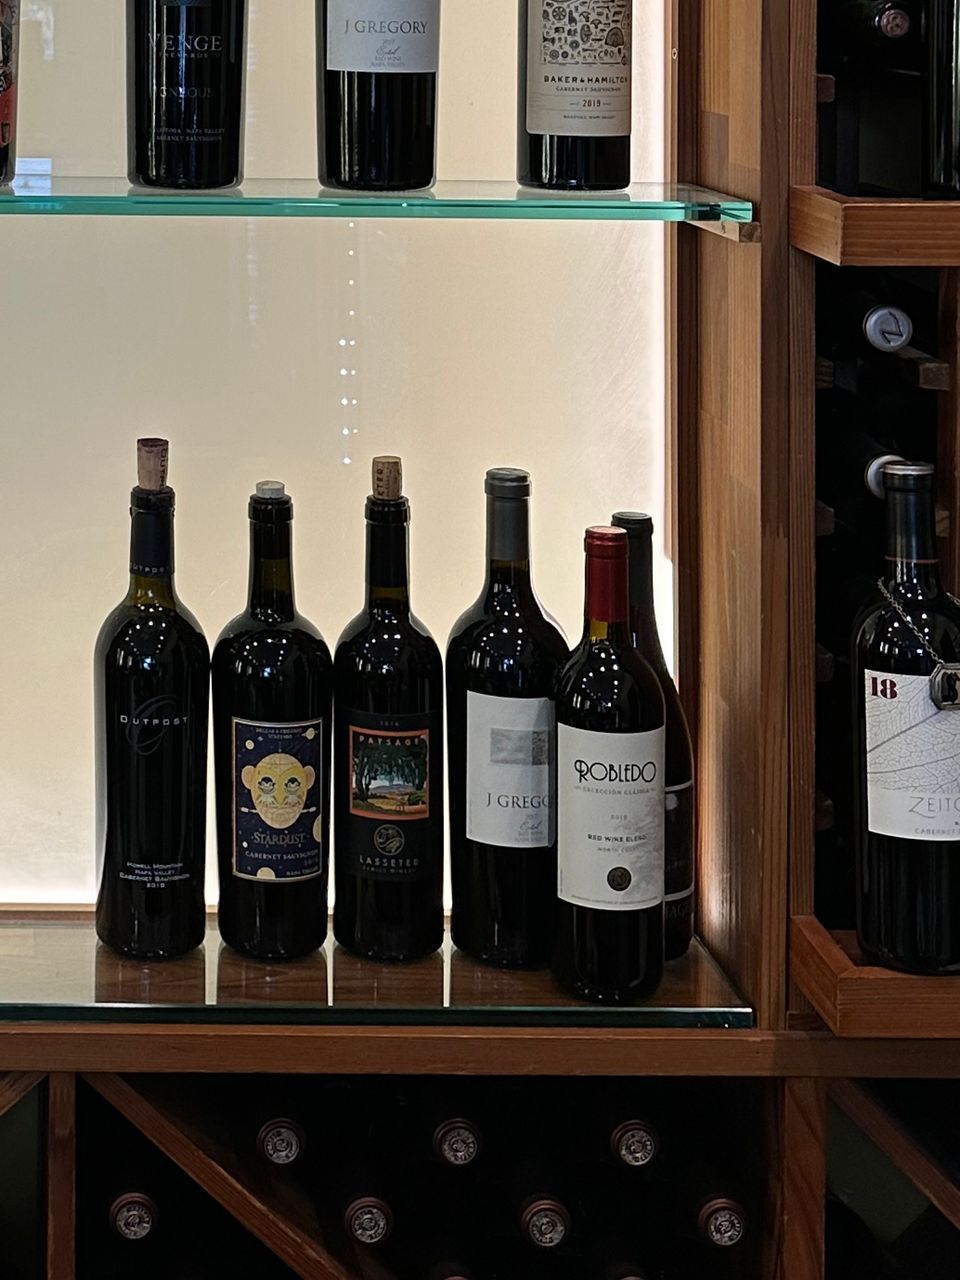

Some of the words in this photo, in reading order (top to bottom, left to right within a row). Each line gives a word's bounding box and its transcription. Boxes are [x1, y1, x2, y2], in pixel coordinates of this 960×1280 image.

[343, 20, 349, 34] J
[354, 20, 429, 35] GREGORY
[147, 33, 224, 51] VENGE
[544, 75, 578, 83] BAKER
[871, 677, 897, 699] 18
[120, 714, 189, 726] OUTPOST
[359, 735, 419, 746] PAYSAGE
[574, 759, 657, 783] ROBLEDO
[486, 792, 492, 808] J
[253, 831, 306, 845] STARDUST
[587, 833, 603, 841] RED
[245, 851, 282, 860] CABERNET
